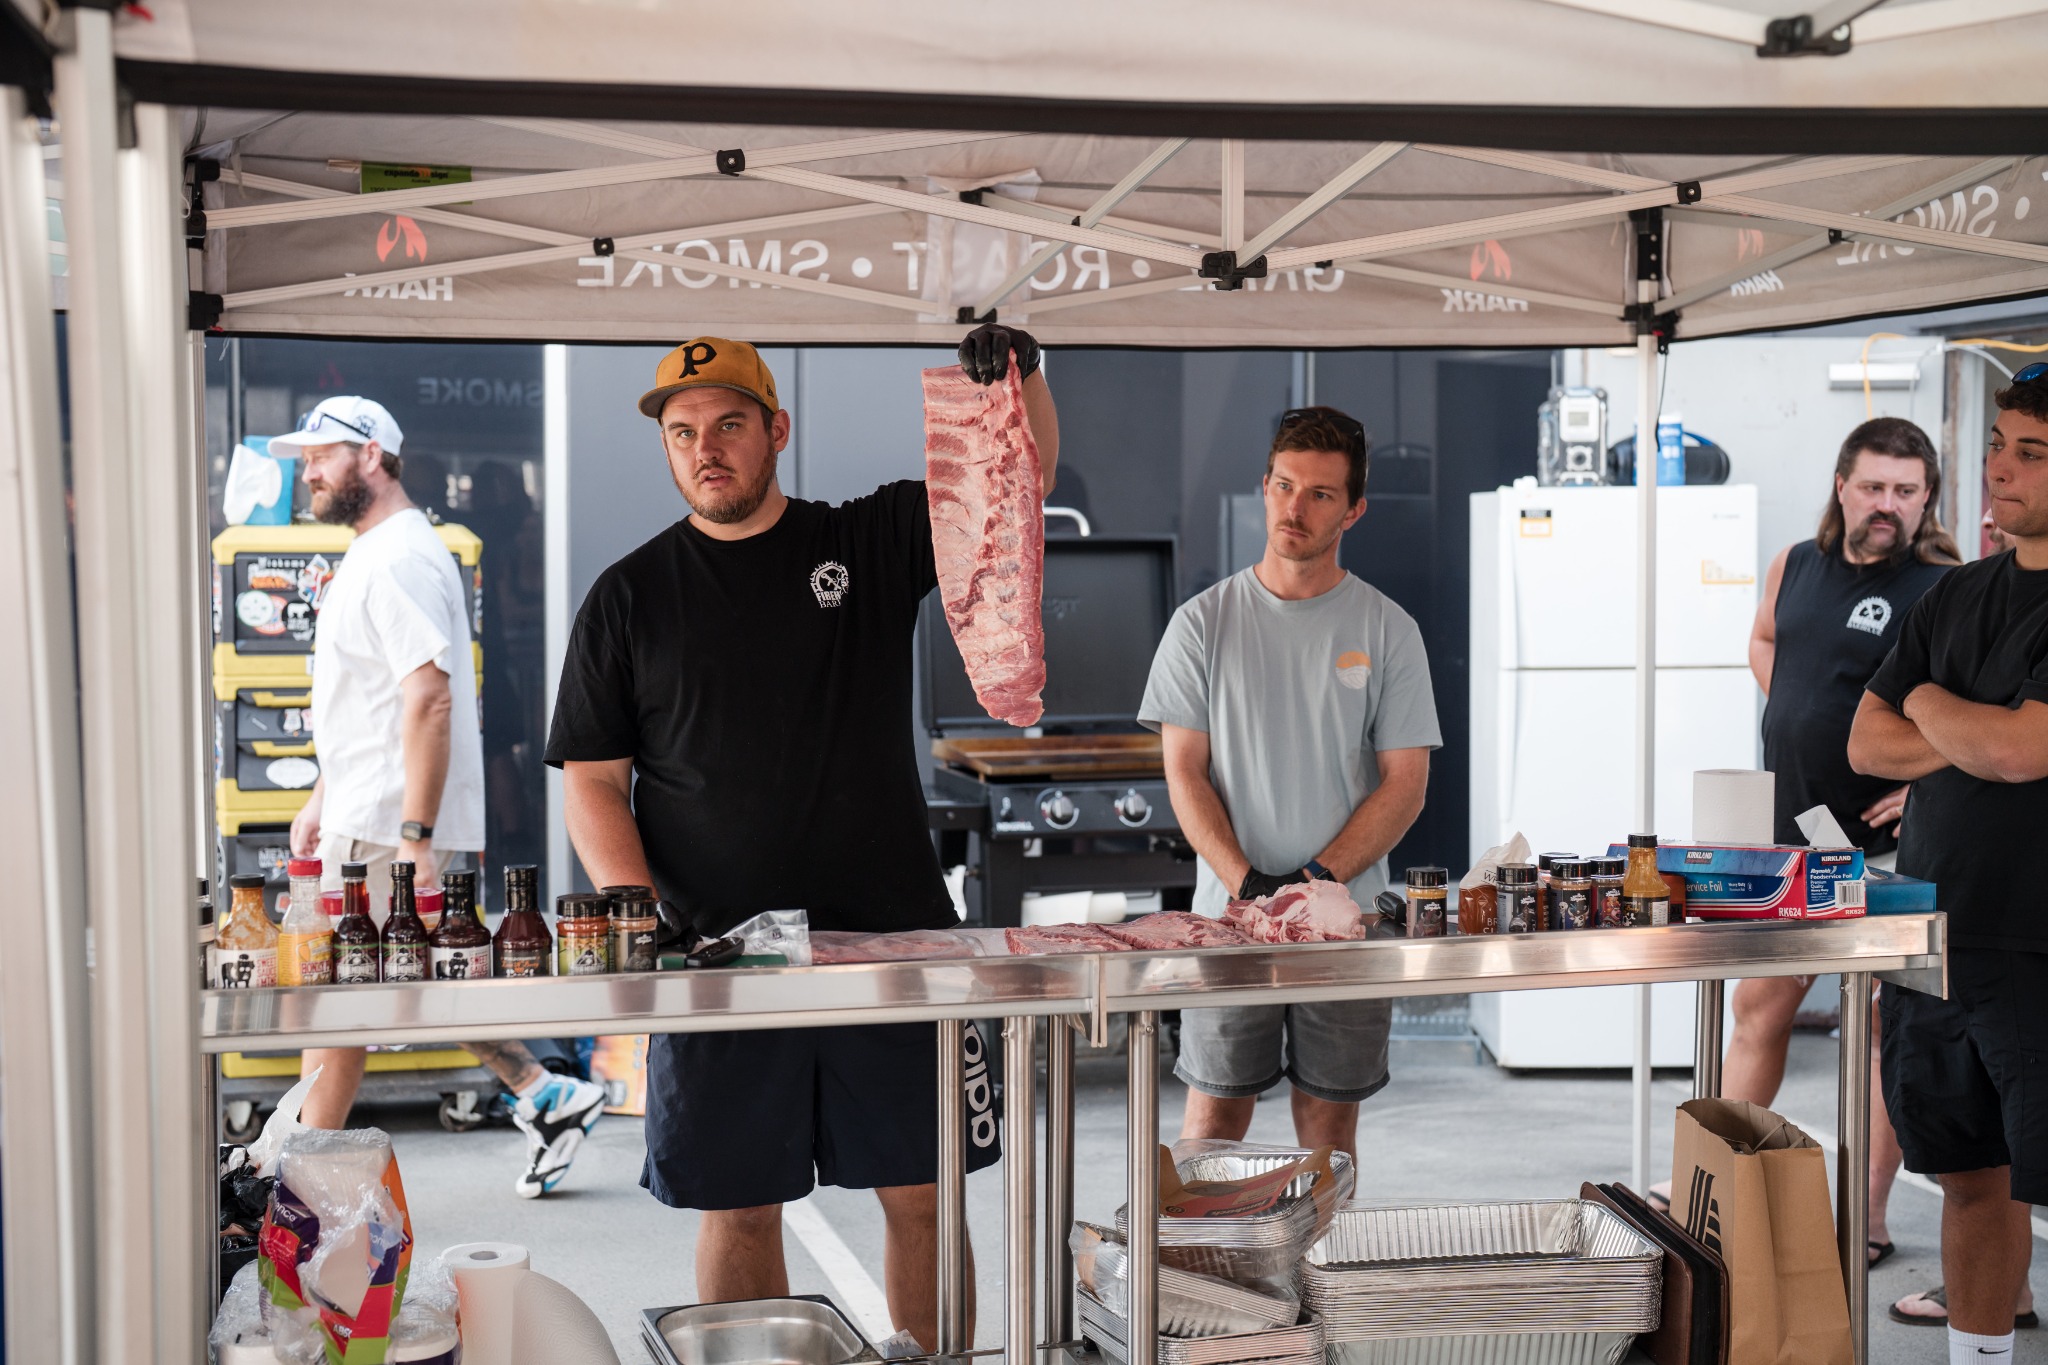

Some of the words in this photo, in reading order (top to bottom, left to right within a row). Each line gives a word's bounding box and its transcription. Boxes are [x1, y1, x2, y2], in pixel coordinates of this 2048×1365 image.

[678, 342, 717, 379] P
[1686, 851, 1713, 860] KIRKLAND
[1686, 881, 1709, 892] ervice
[1709, 880, 1724, 893] Foil
[1778, 907, 1802, 917] RK624
